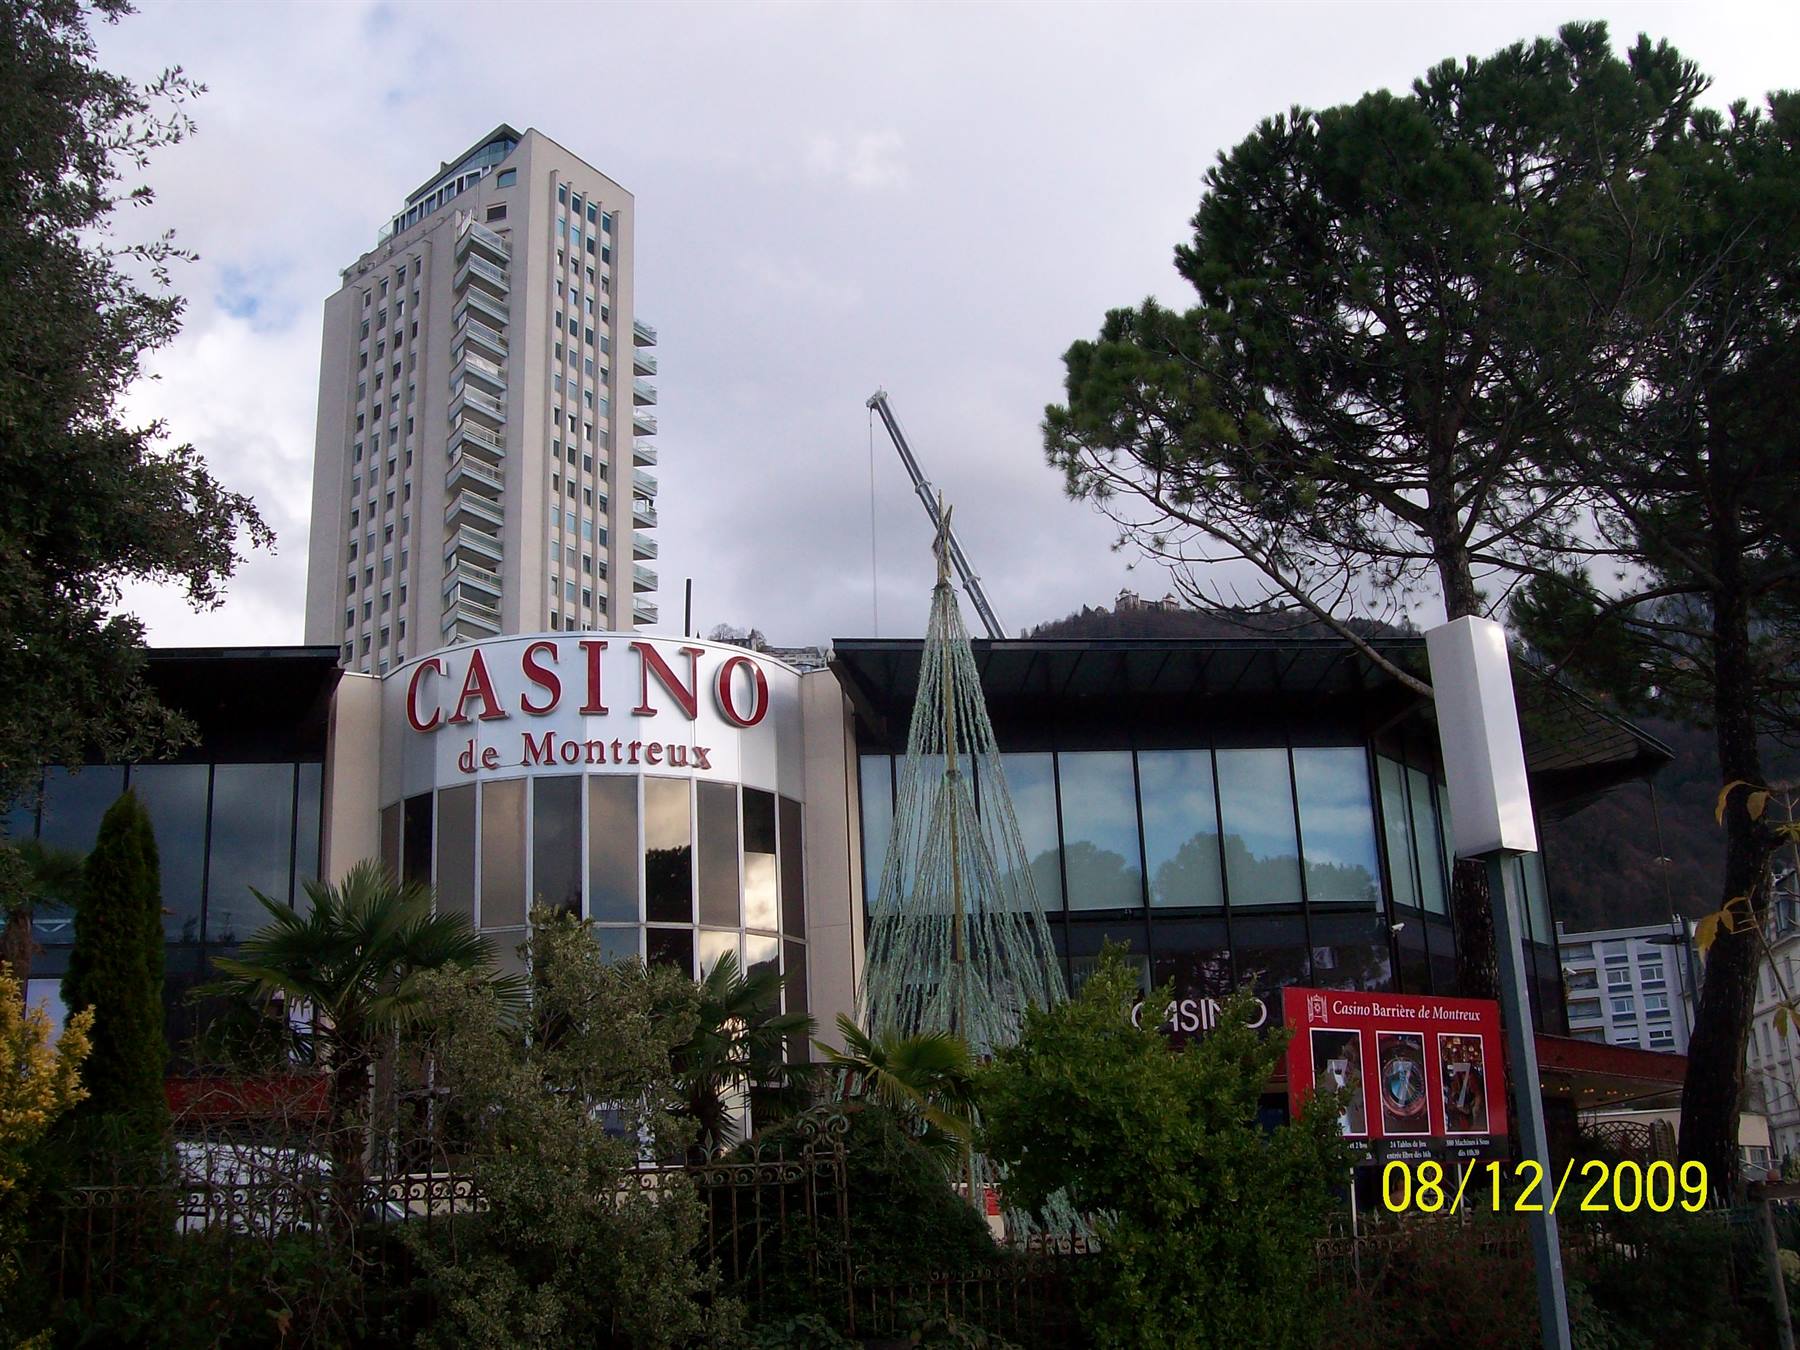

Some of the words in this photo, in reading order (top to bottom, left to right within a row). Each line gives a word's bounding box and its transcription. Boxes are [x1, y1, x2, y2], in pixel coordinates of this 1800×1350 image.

[406, 640, 770, 734] CASINO
[458, 738, 499, 774] de
[521, 730, 712, 769] Montreux
[1333, 1000, 1370, 1016] Casino
[1372, 1002, 1415, 1018] Barrière
[1418, 1004, 1430, 1019] de
[1432, 1006, 1480, 1021] Montreux
